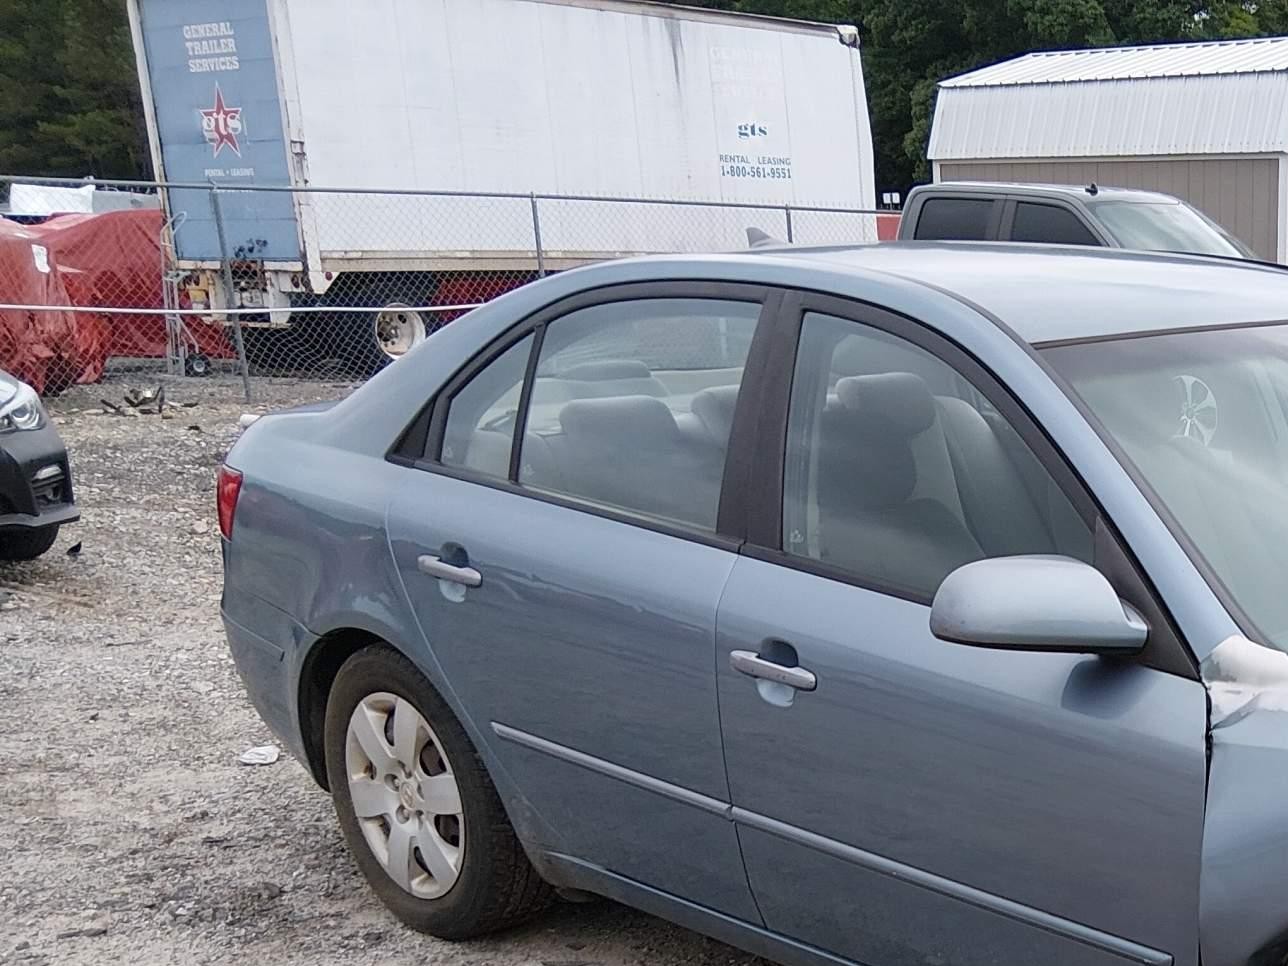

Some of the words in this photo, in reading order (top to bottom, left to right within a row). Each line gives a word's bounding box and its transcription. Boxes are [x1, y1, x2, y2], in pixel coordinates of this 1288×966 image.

[183, 22, 234, 39] GENERAL
[185, 38, 236, 55] TRAILER
[188, 56, 239, 72] SERVICES
[738, 123, 767, 140] gts
[719, 153, 750, 164] RENTAL
[757, 156, 791, 165] LEASING
[721, 165, 791, 179] 1-800-561-9551
